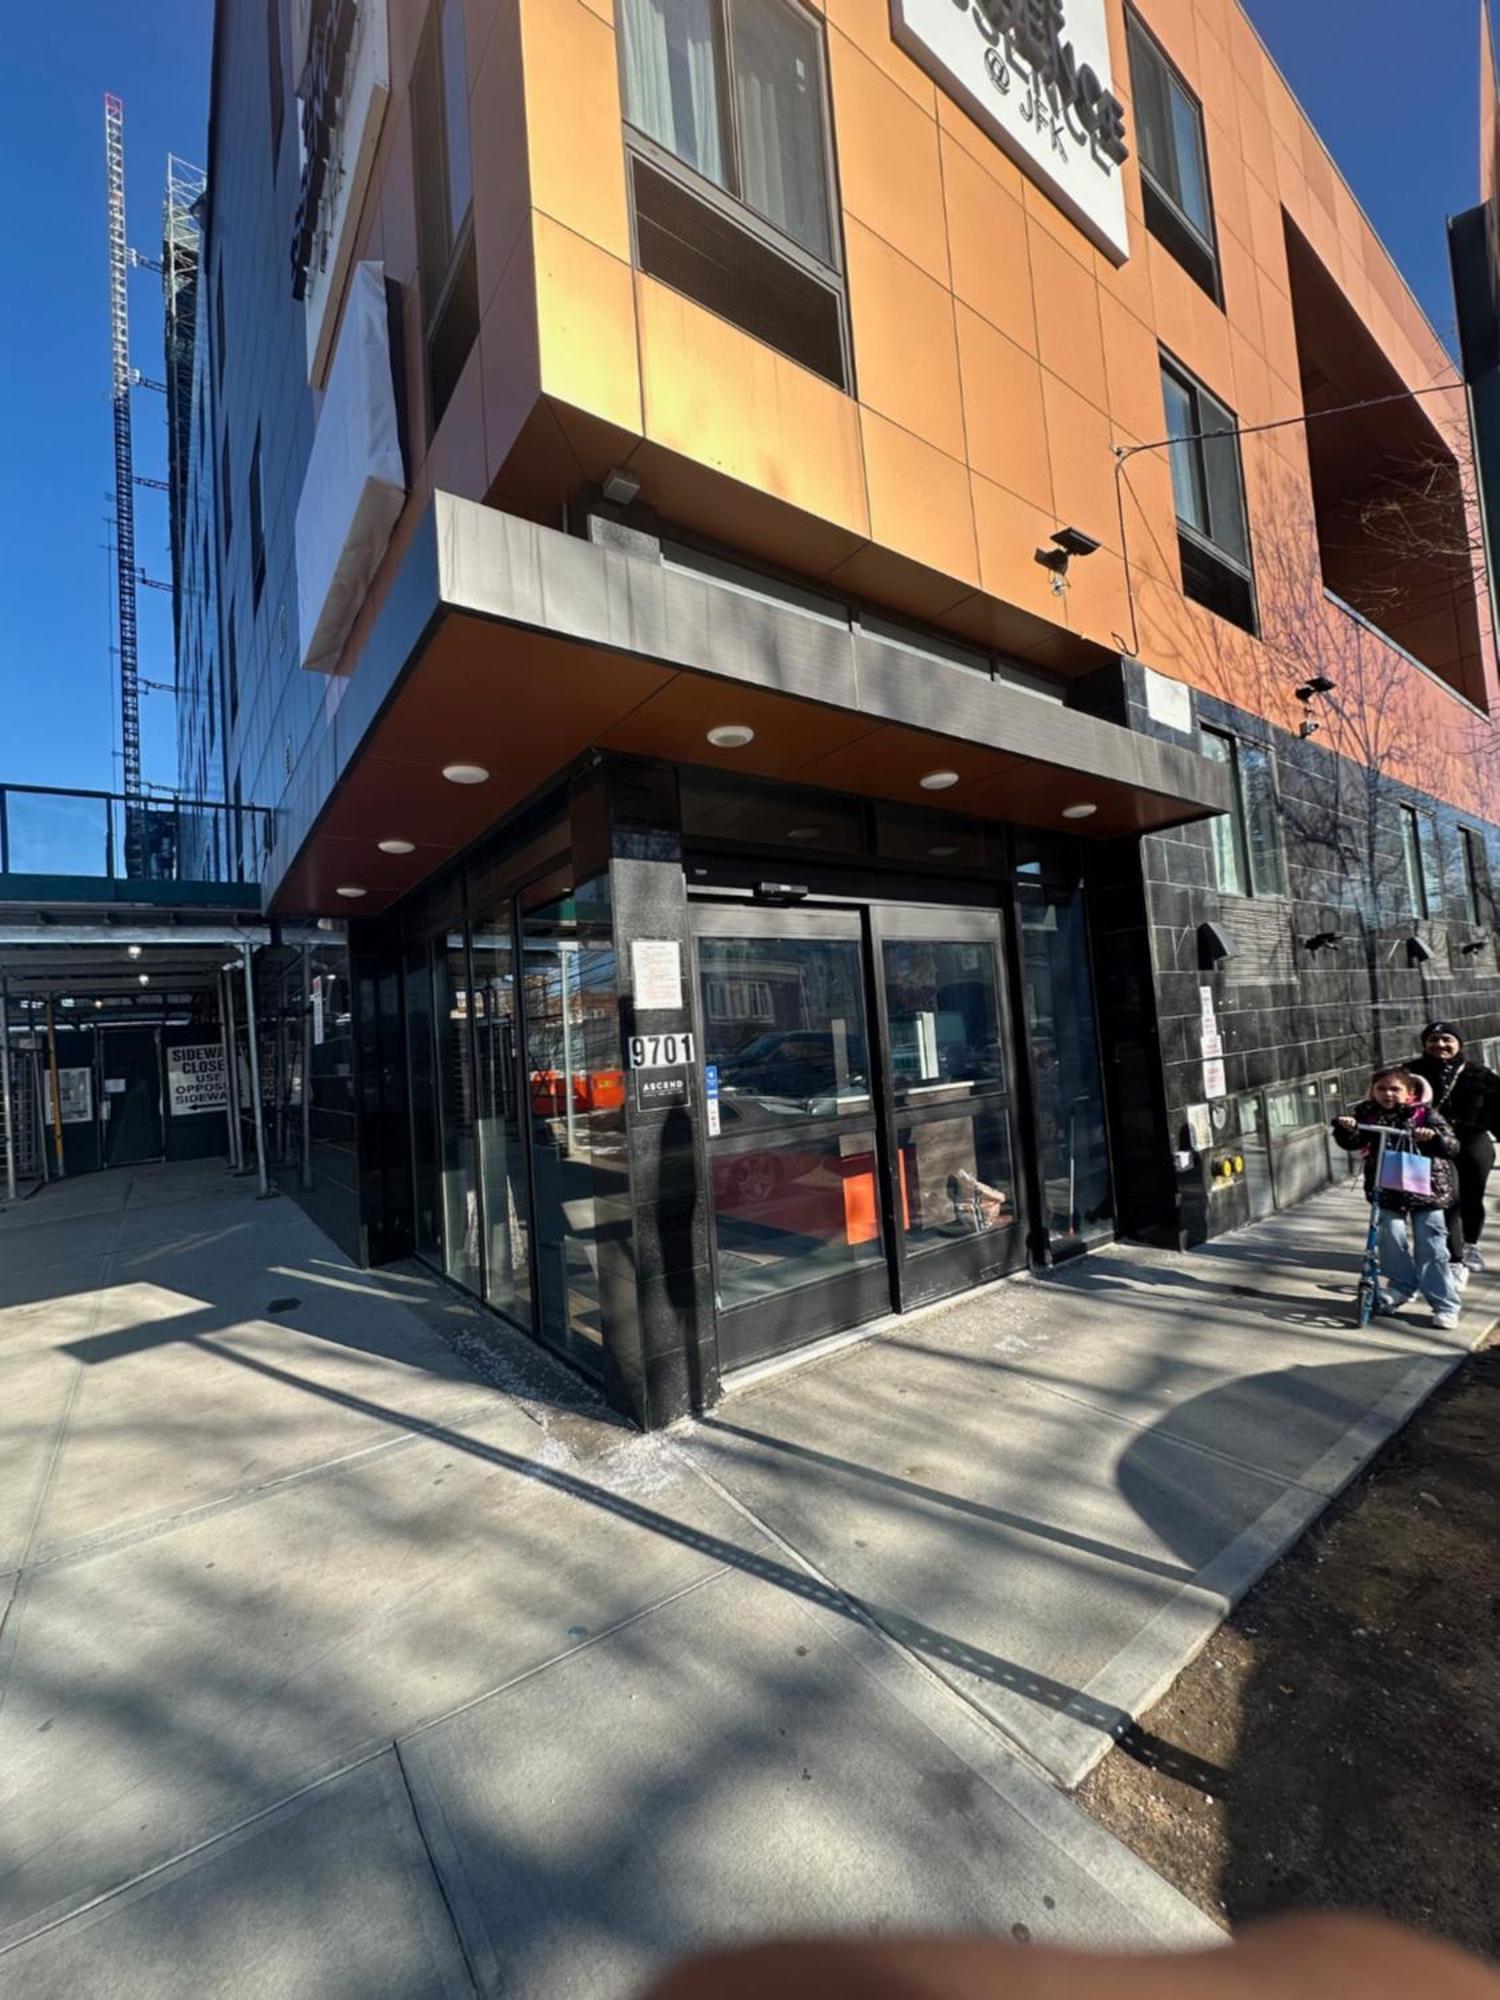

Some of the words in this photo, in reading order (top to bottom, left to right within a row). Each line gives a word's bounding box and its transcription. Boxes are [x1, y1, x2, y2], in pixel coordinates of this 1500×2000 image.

[1018, 90, 1068, 164] JFK
[632, 1034, 691, 1067] 9701
[182, 1059, 226, 1074] CLOSE
[643, 1080, 683, 1092] ASCEND
[175, 1090, 244, 1104] SIDEWA
